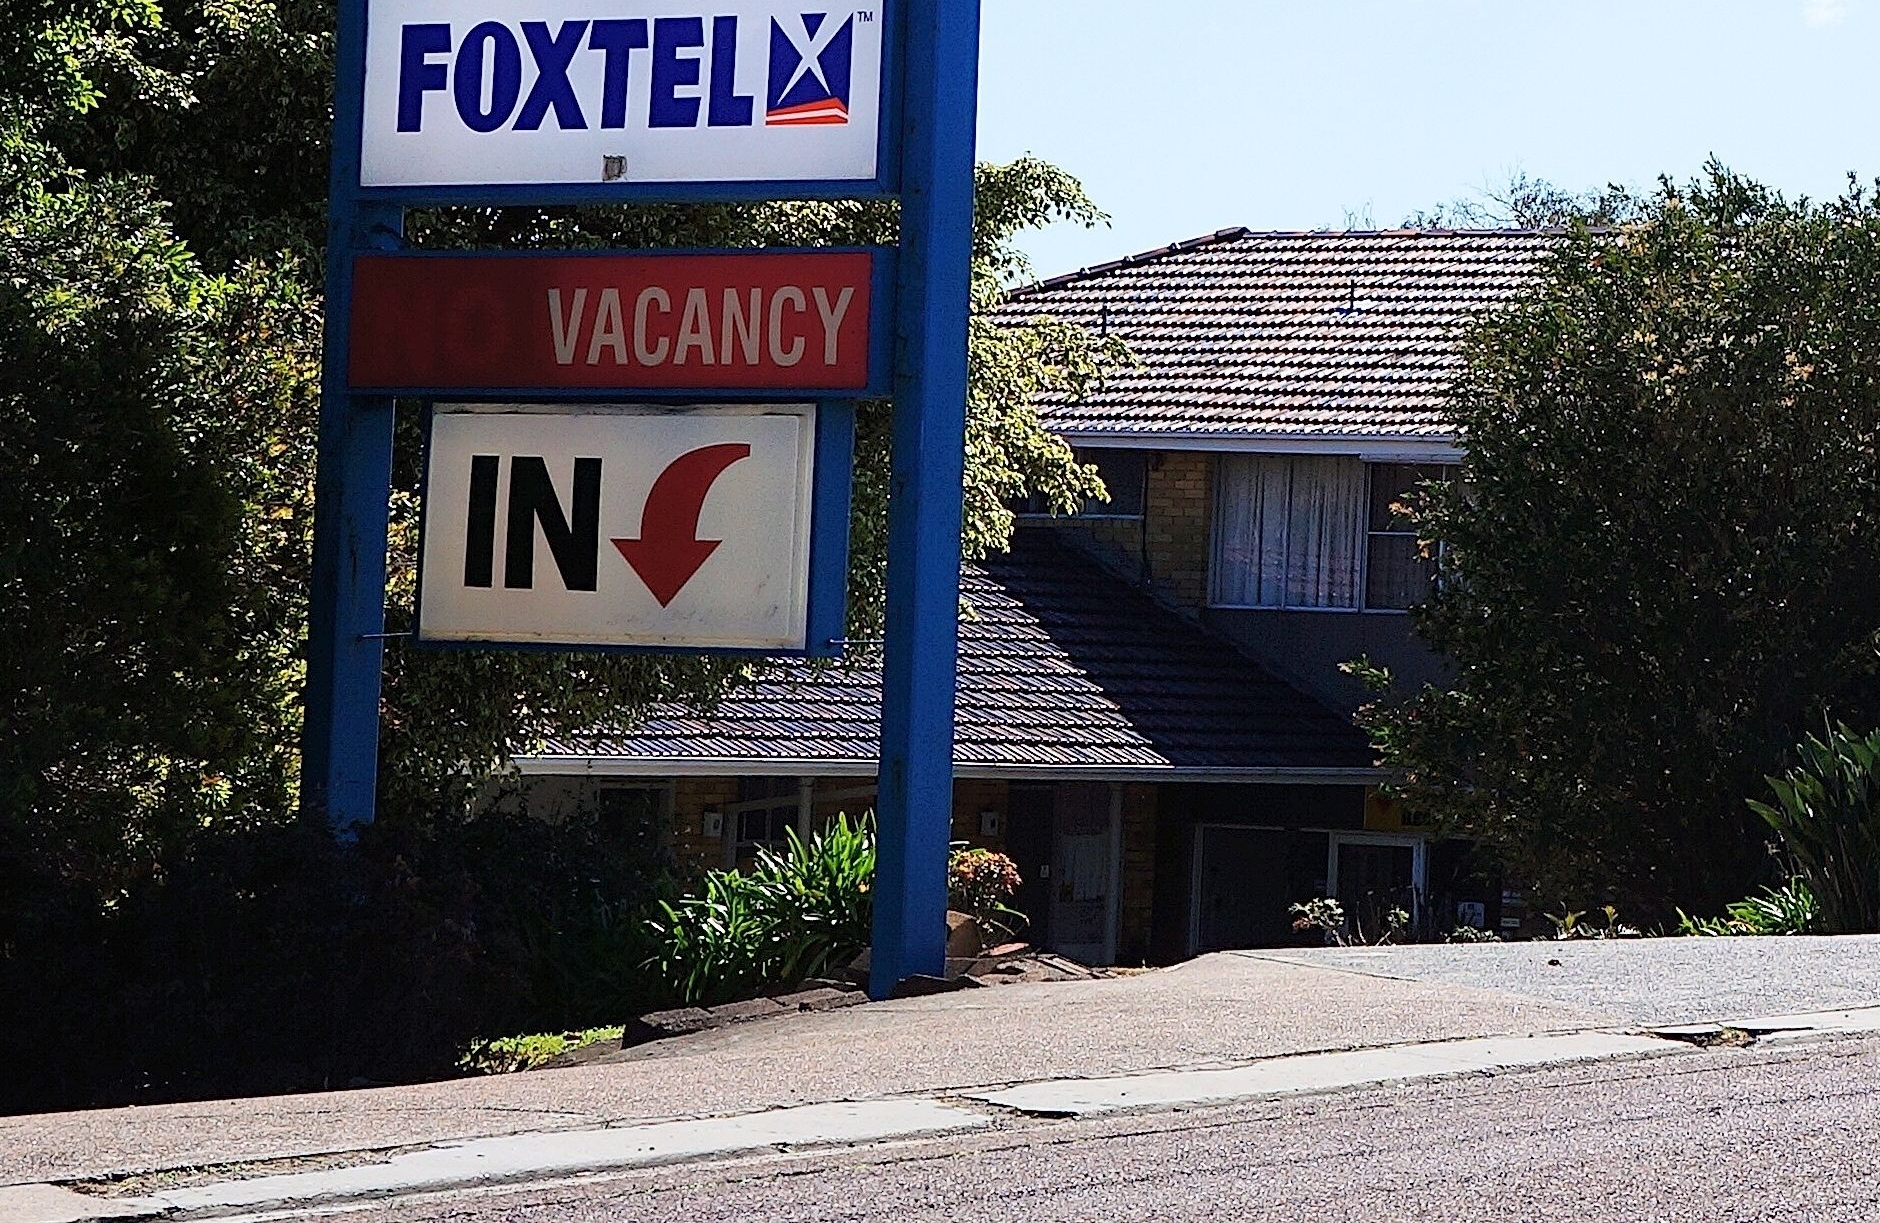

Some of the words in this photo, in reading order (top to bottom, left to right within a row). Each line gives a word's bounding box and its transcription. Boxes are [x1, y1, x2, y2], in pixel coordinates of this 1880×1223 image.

[857, 11, 873, 23] TM
[397, 15, 753, 133] FOXTEL
[547, 286, 854, 366] VACANCY
[464, 454, 602, 592] IN
